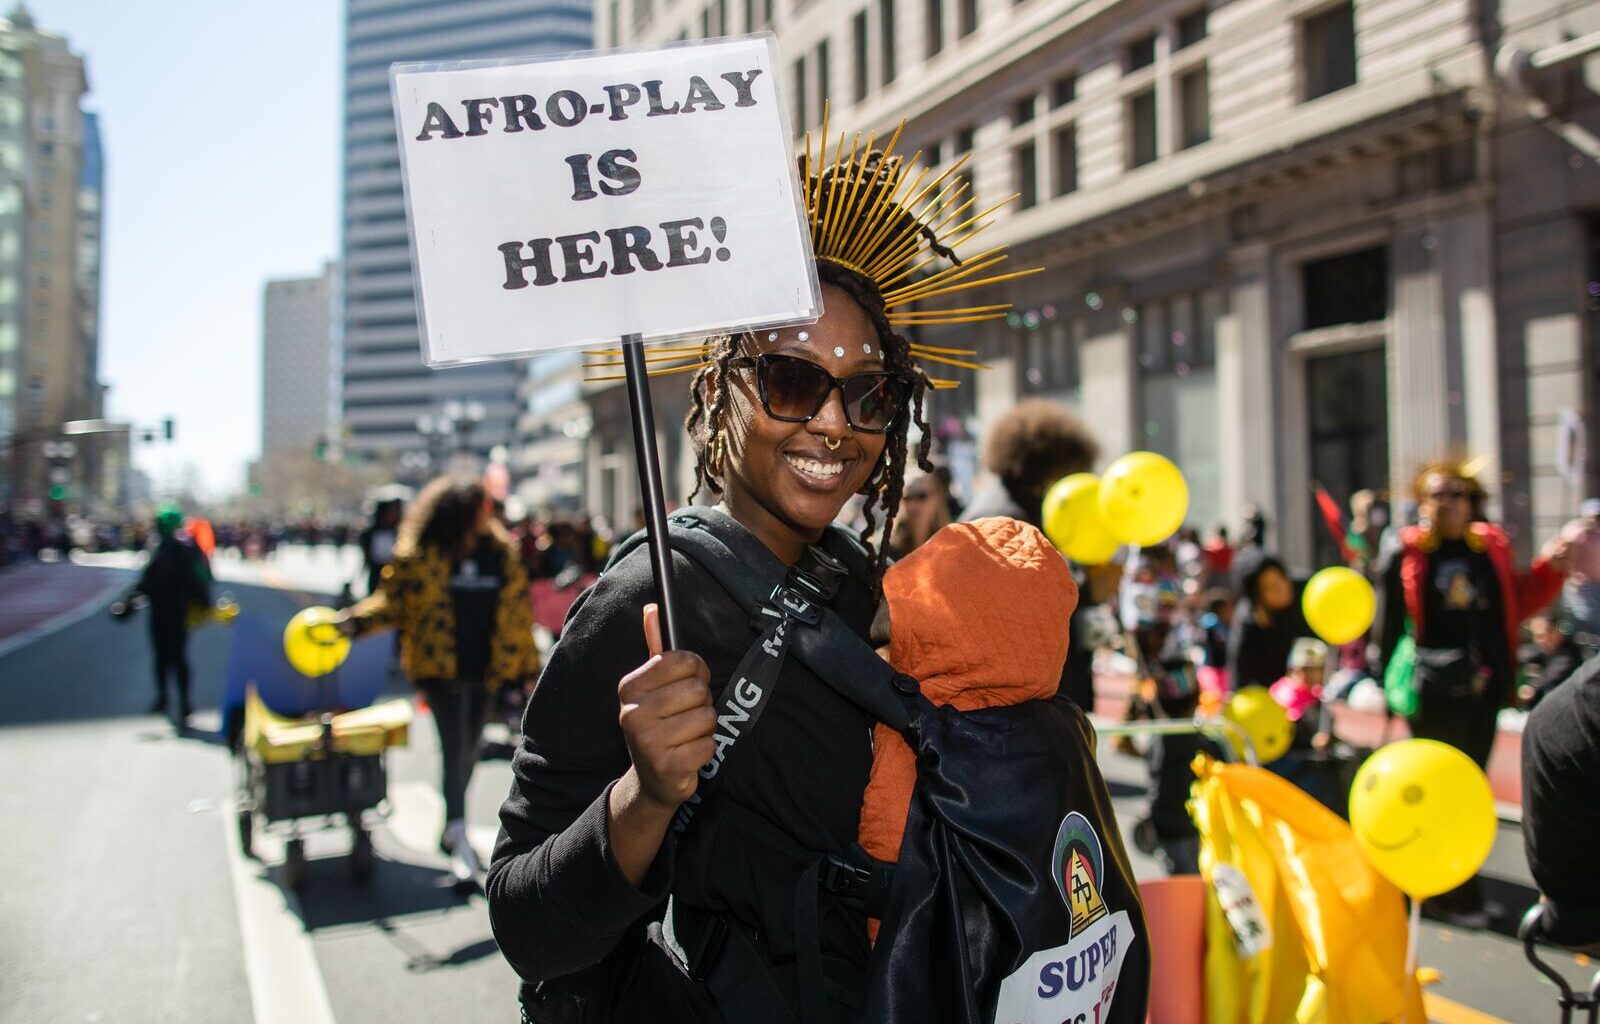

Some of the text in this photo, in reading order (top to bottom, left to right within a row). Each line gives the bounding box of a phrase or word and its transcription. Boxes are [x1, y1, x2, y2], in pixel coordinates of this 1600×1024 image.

[415, 69, 763, 141] AFRO-PLAY
[564, 149, 641, 201] IS
[498, 216, 731, 290] HERE!
[1037, 924, 1117, 999] SUPER
